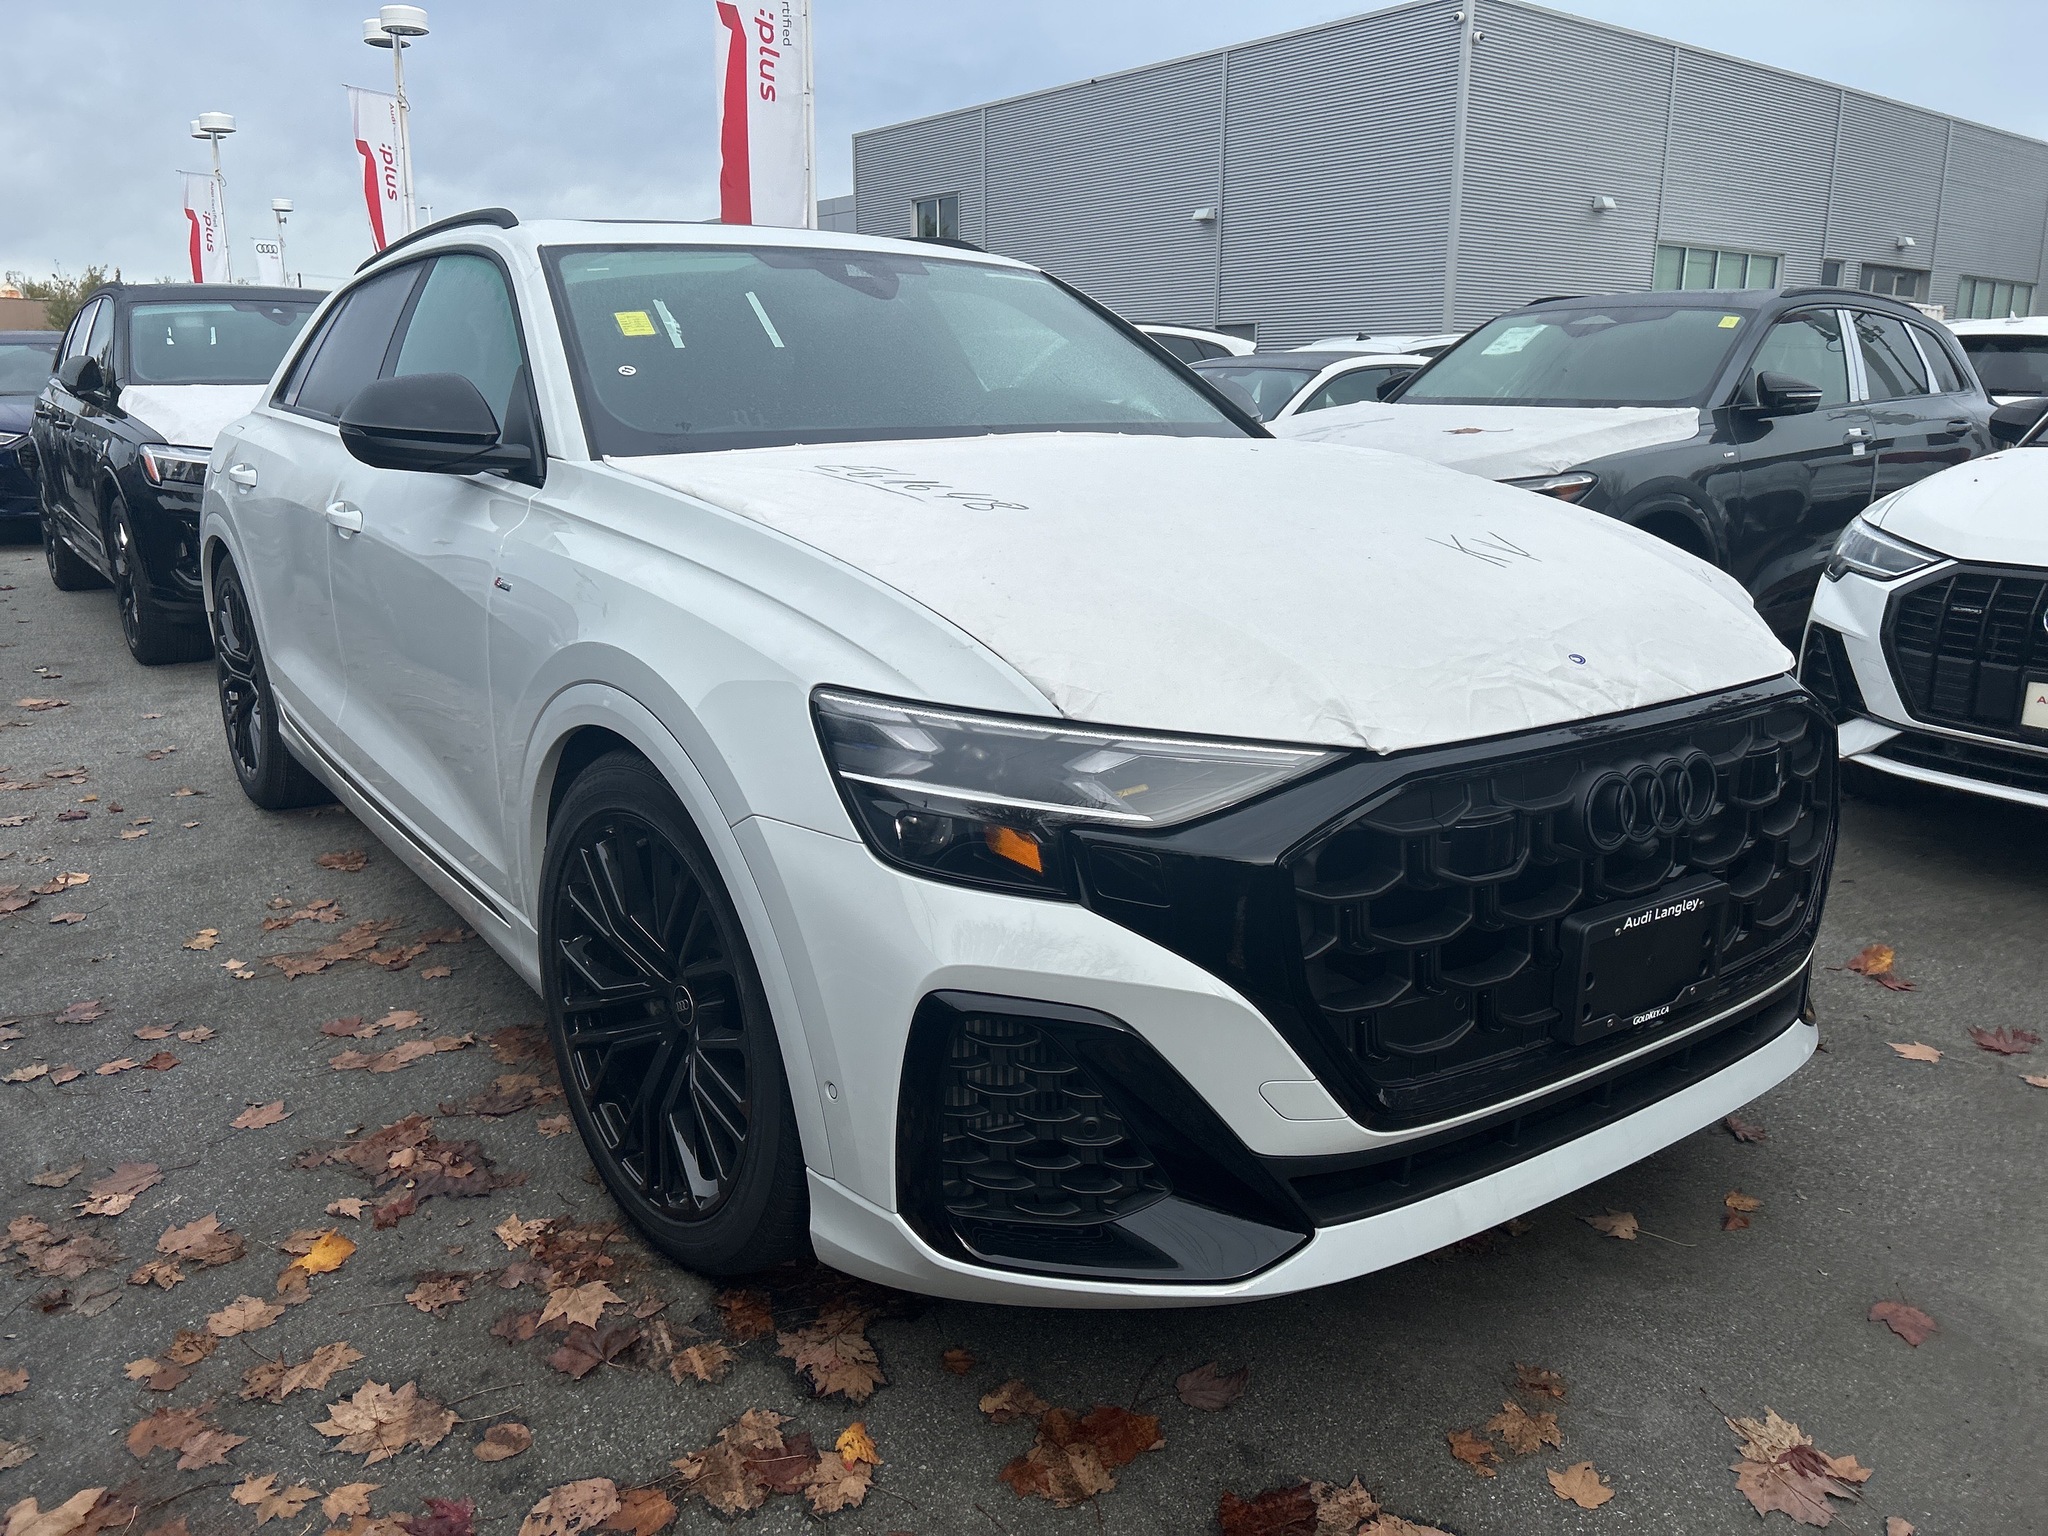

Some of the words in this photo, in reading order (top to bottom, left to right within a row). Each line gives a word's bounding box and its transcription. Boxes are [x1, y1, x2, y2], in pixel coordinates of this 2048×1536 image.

[754, 8, 780, 102] :plus
[379, 142, 398, 201] :plus
[202, 210, 214, 253] :plus
[1623, 911, 1652, 930] Audi
[1655, 898, 1700, 918] Langley
